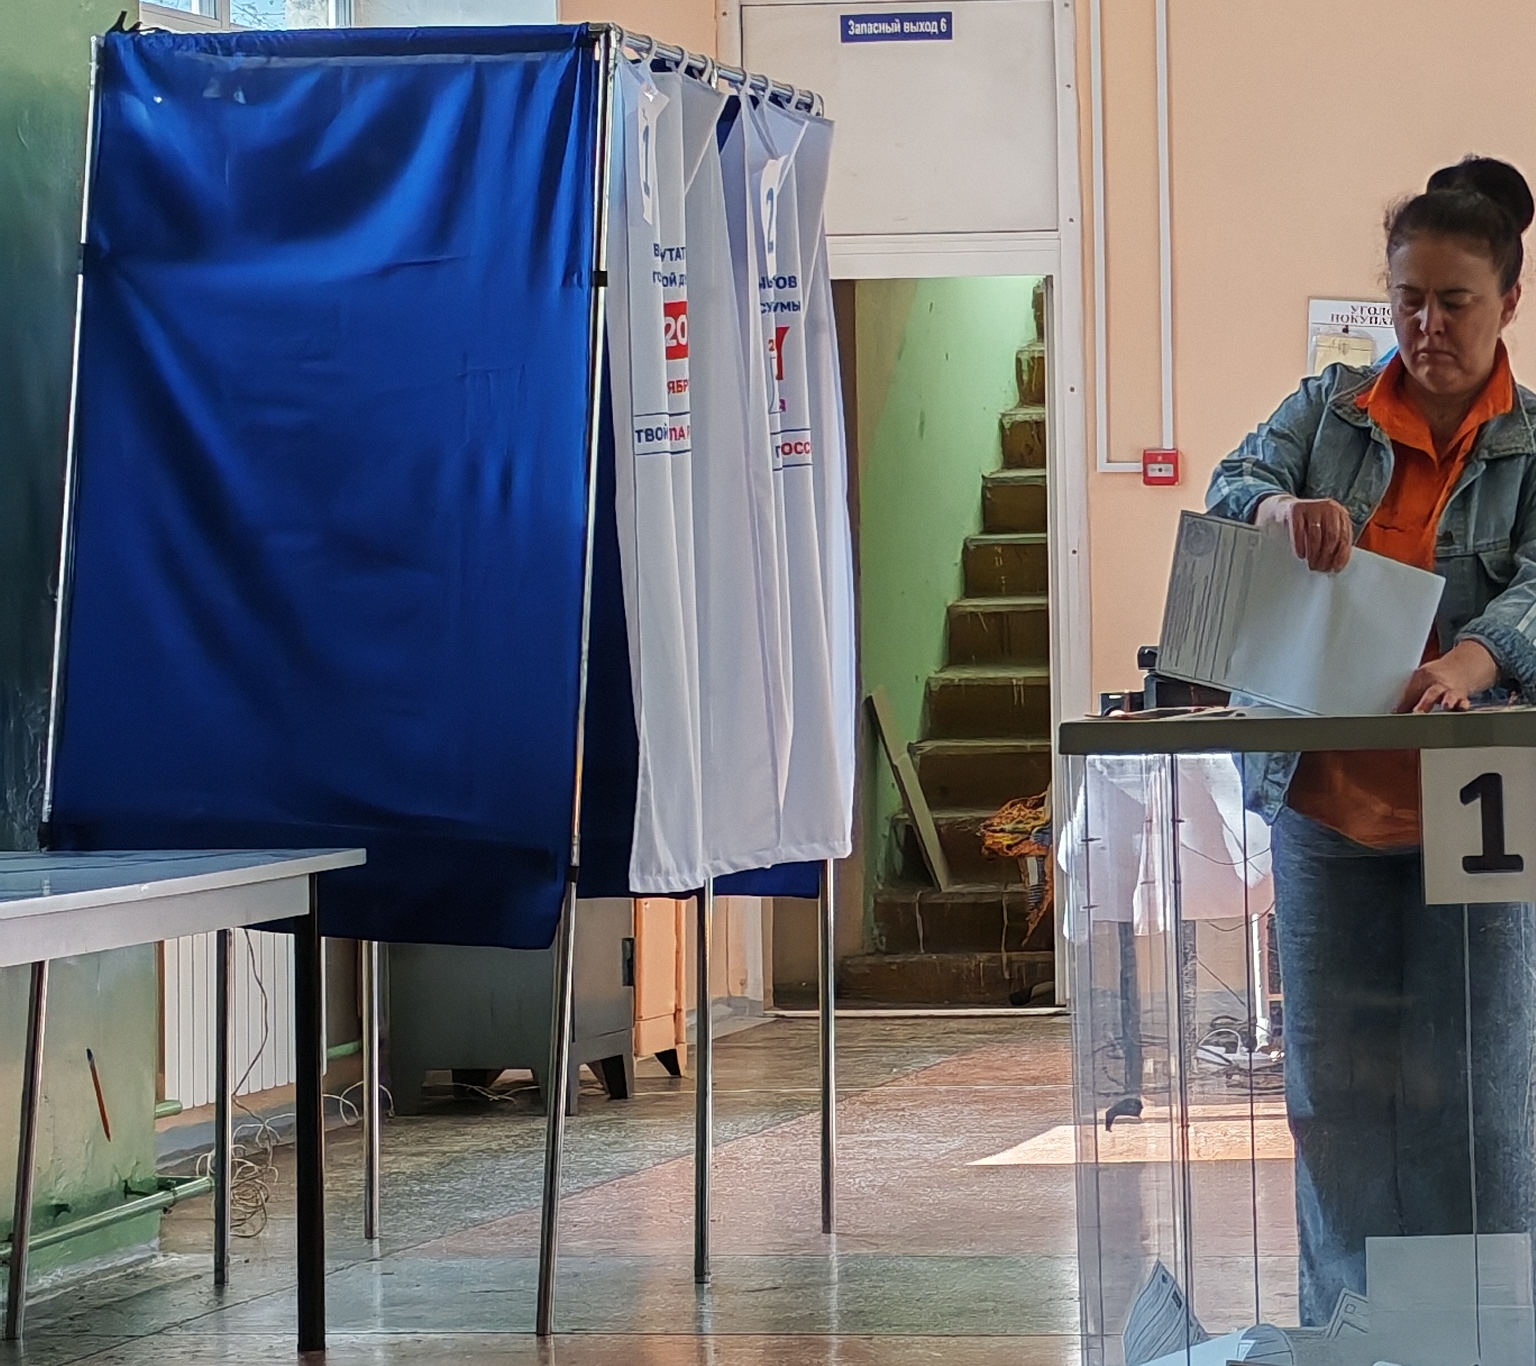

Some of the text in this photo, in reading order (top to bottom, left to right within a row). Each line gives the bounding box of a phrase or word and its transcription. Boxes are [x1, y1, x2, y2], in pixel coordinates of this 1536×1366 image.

[848, 17, 947, 36] Запасный выход 6
[665, 314, 688, 347] 20
[1459, 772, 1524, 874] 1
